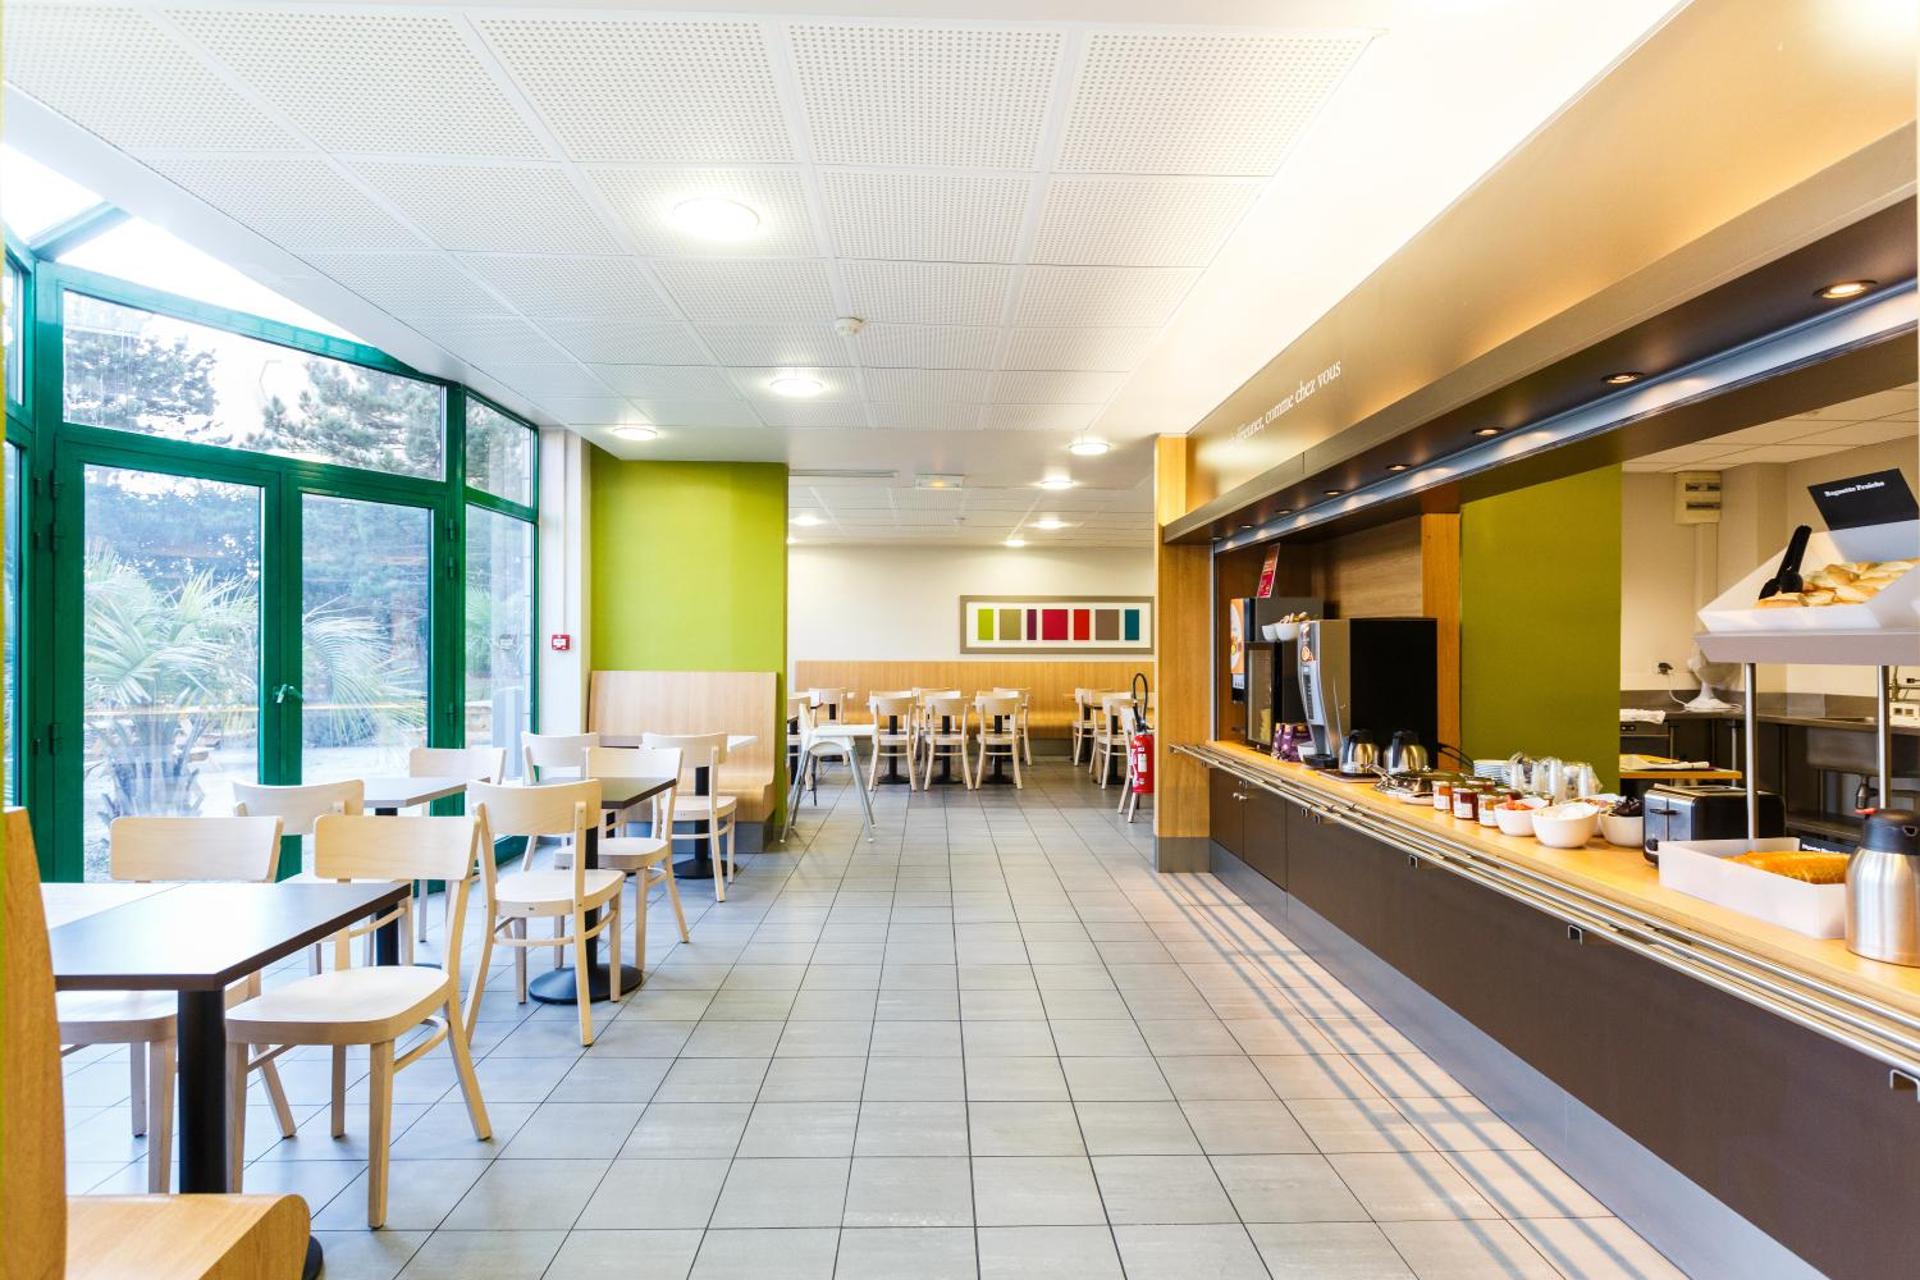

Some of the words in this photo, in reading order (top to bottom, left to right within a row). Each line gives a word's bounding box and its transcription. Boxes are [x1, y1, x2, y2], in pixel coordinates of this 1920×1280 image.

[1265, 394, 1294, 424] comme
[1295, 380, 1316, 403] chez
[1317, 360, 1341, 388] vous
